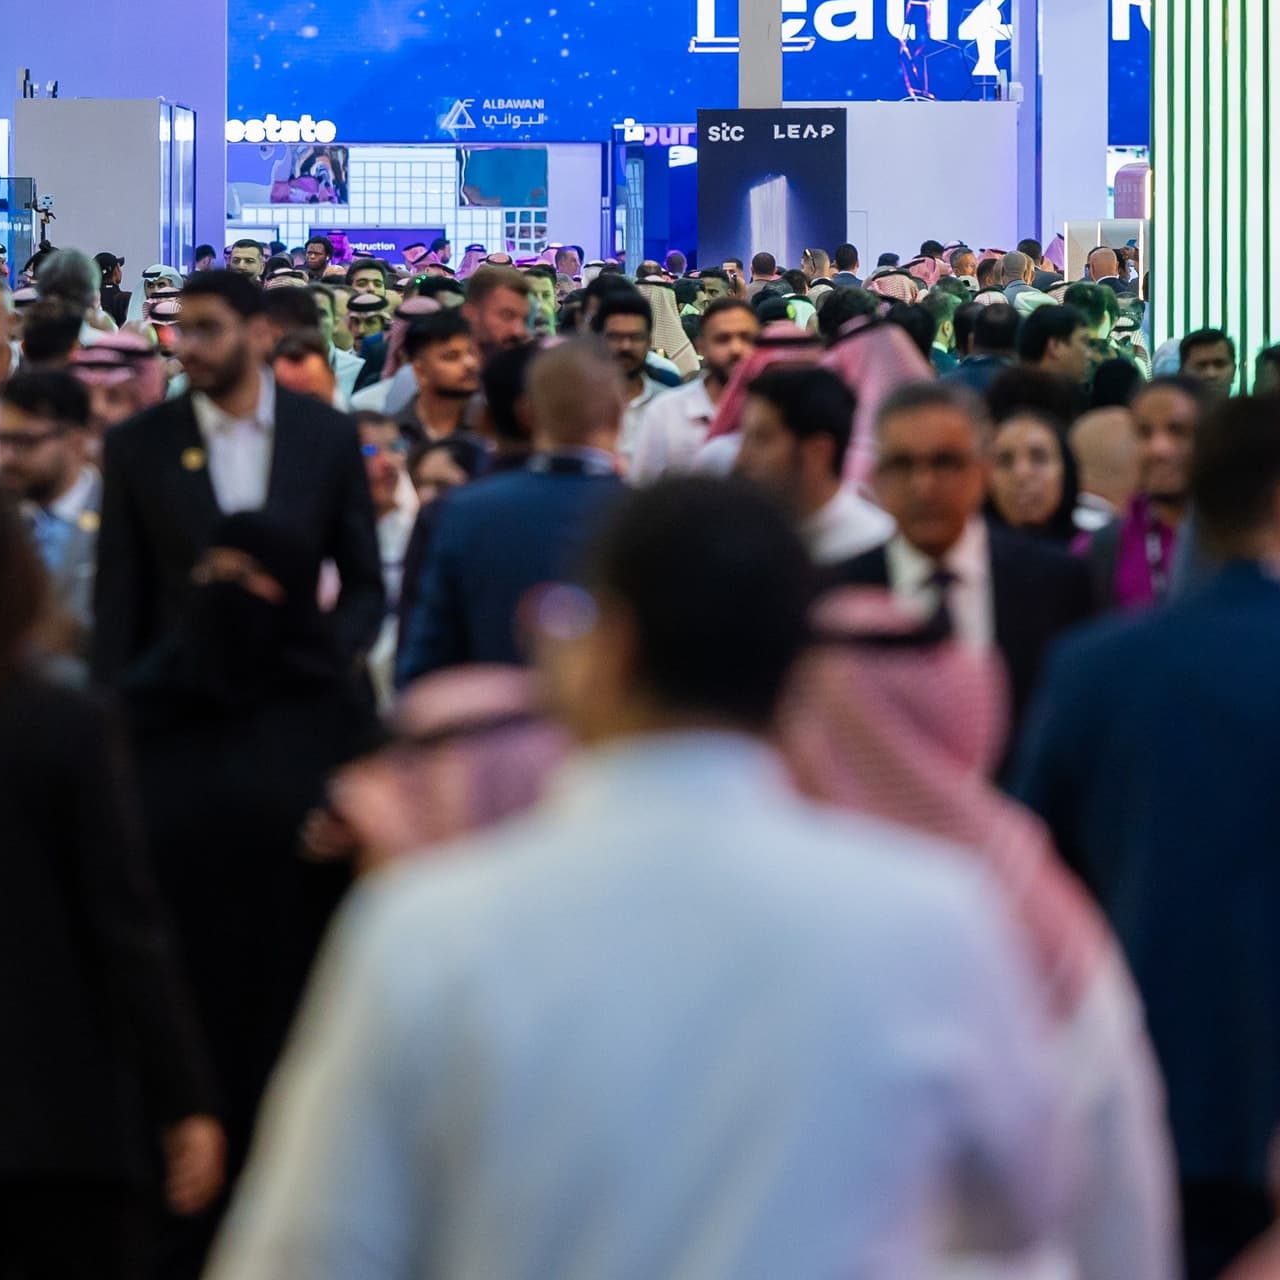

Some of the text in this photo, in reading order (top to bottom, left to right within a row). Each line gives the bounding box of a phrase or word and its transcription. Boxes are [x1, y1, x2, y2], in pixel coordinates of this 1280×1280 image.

[483, 99, 545, 109] ALBAWANI
[707, 122, 836, 142] stc LEAP
